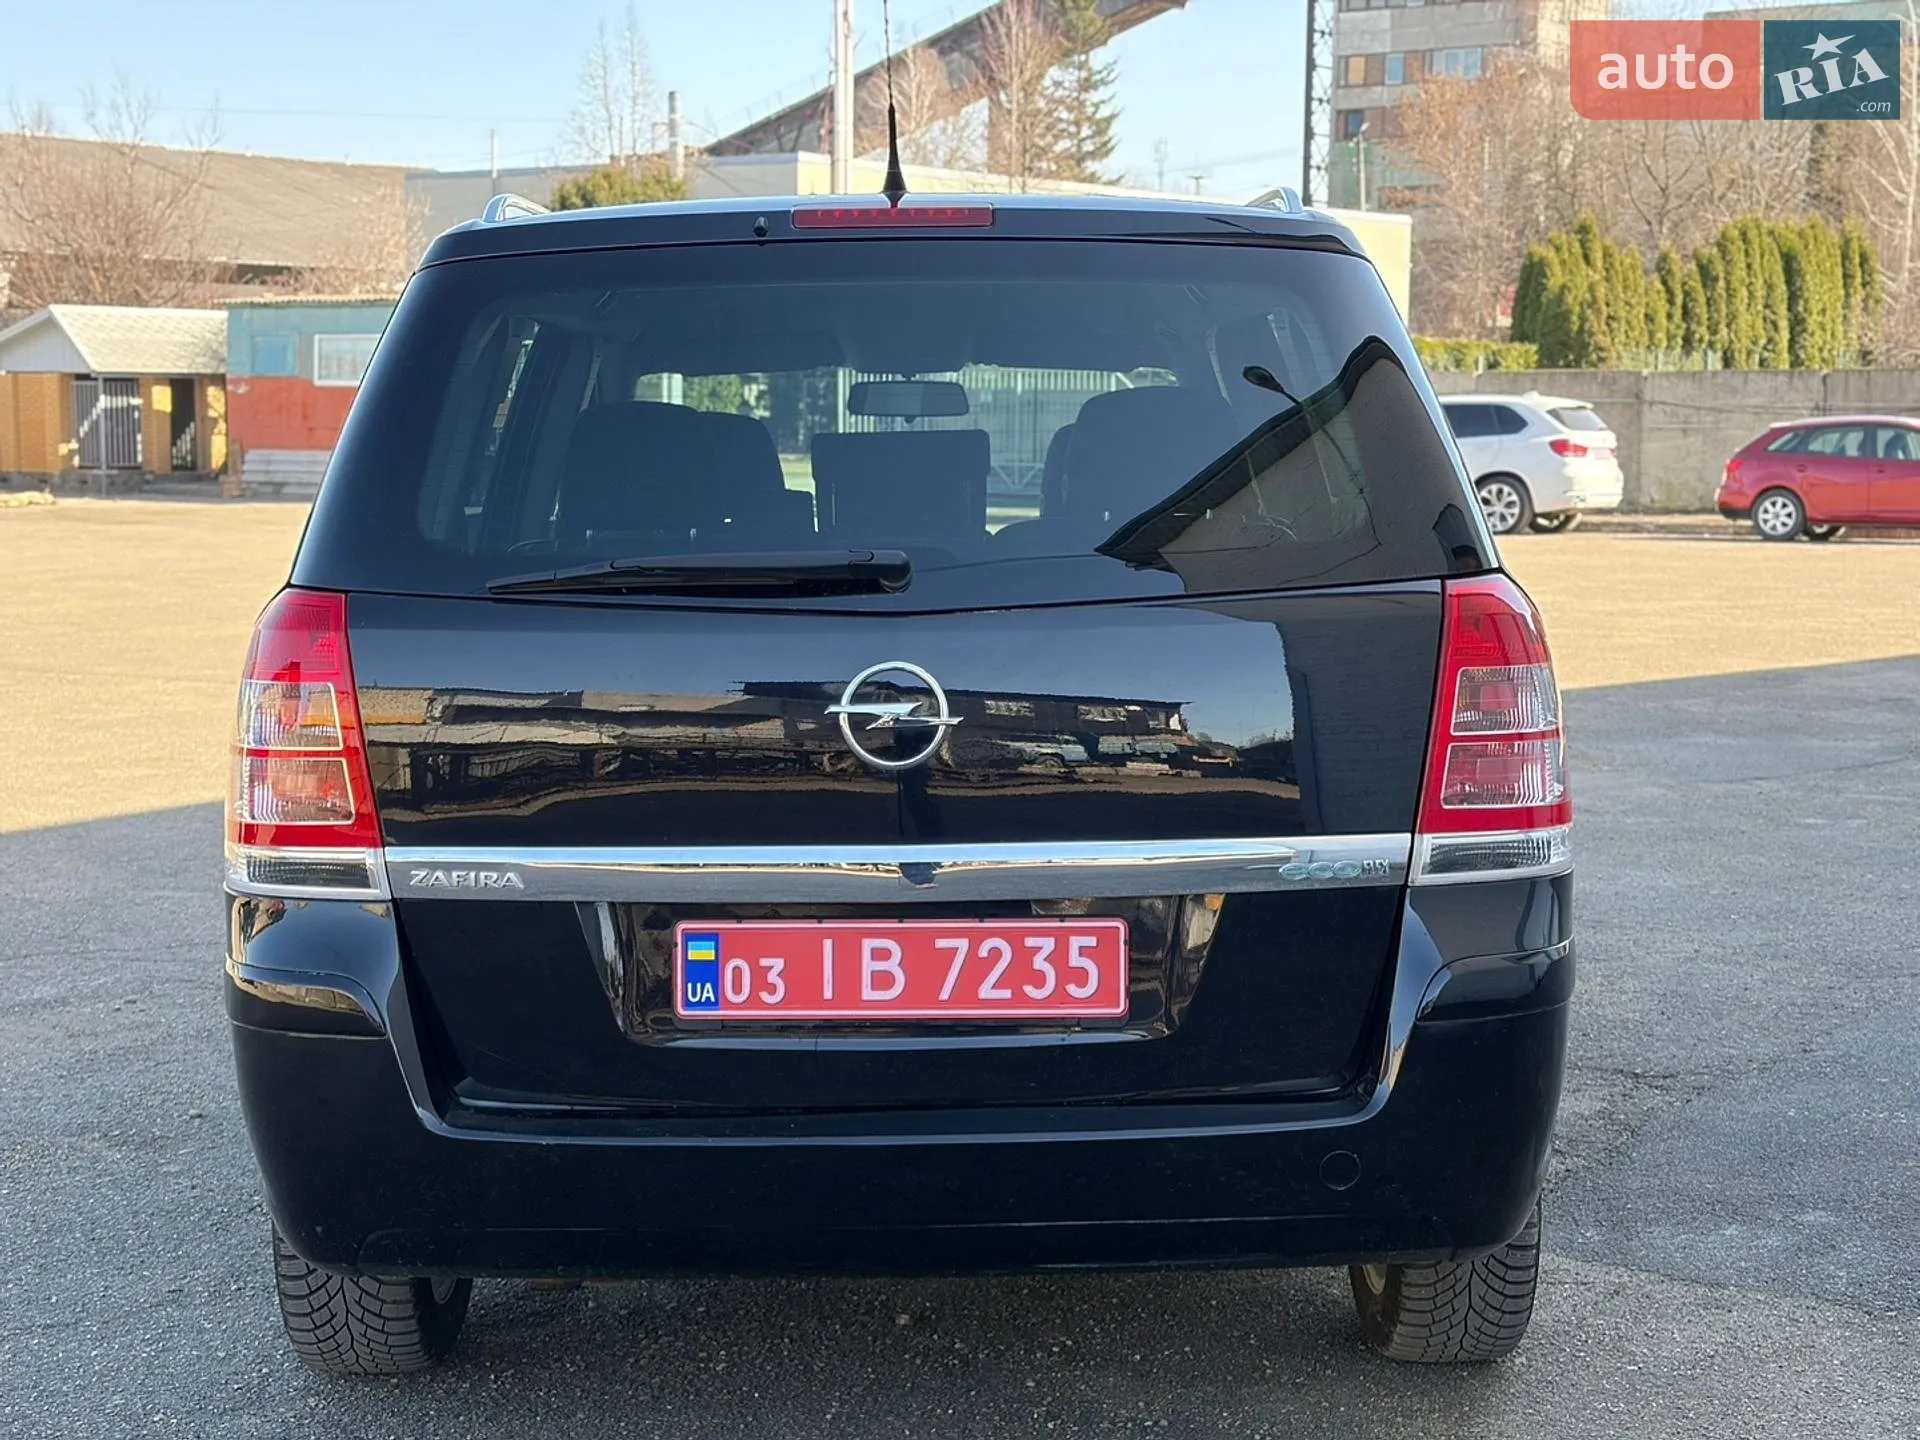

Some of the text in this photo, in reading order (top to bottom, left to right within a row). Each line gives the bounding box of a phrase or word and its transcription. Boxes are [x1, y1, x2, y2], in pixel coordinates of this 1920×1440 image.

[409, 868, 525, 890] ZAFIRA
[723, 936, 1099, 1004] 03 IB 7235
[687, 982, 716, 1003] UA
